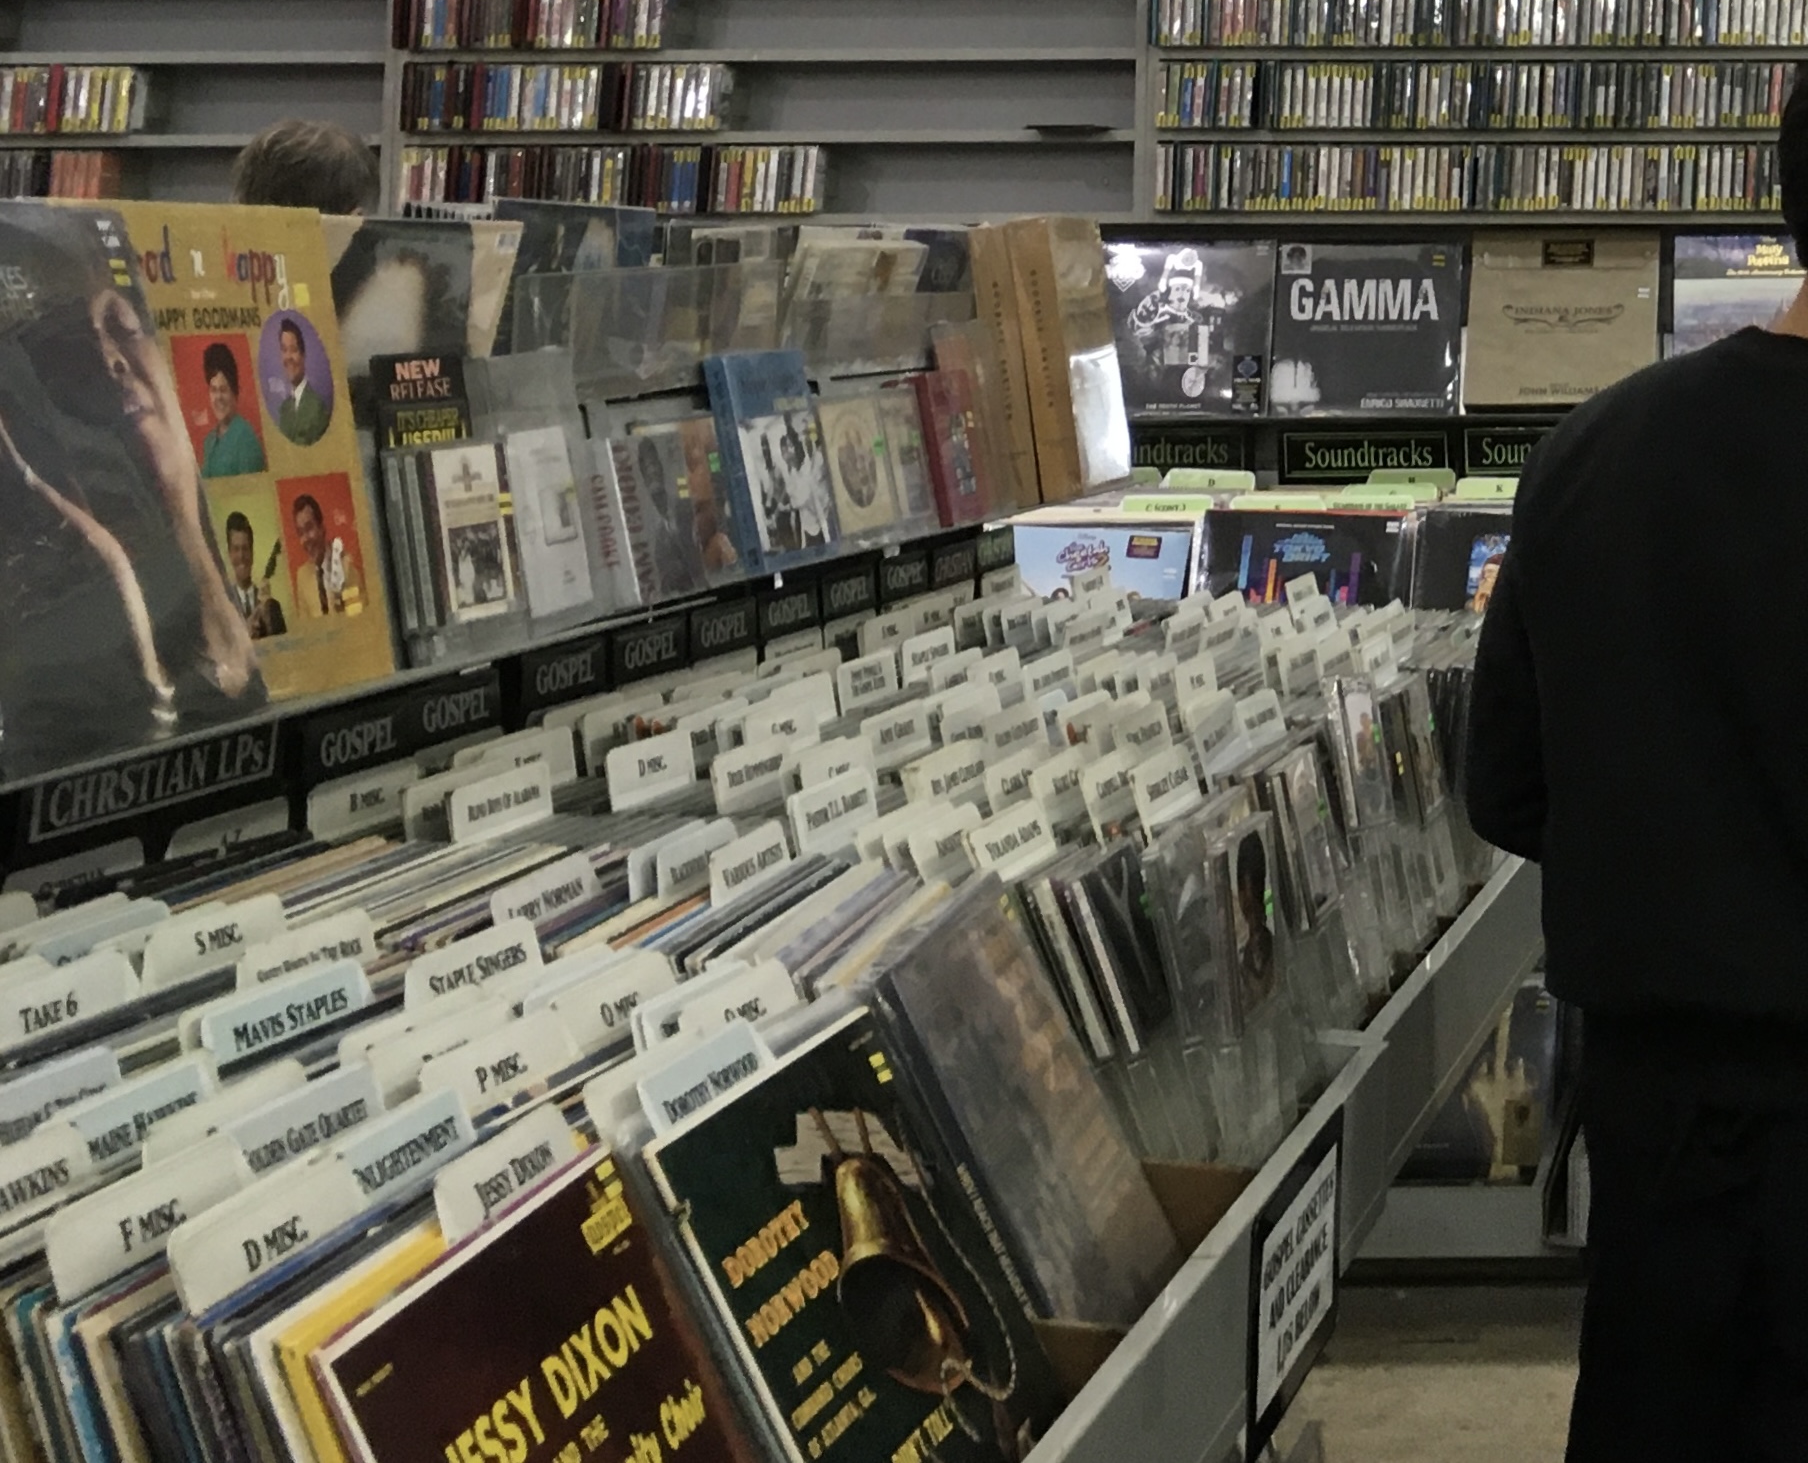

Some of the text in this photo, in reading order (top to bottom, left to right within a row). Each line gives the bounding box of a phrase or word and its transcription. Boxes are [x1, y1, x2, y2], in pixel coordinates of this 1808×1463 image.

[1290, 277, 1439, 322] GAMMA
[1515, 306, 1612, 316] INDIANA JONES
[389, 377, 451, 399] RELEASE
[394, 358, 441, 381] NEW
[1305, 440, 1433, 469] Soundtracks
[1274, 541, 1326, 553] TOKYO
[1282, 550, 1331, 563] DRIFT
[768, 594, 809, 627] GOSPEL
[830, 574, 869, 609] GOSPEL
[624, 631, 678, 671] GOSPEL
[701, 611, 748, 648] GOSPEL
[536, 649, 596, 696] GOSPEL
[422, 687, 490, 734] GOSPEL
[320, 717, 396, 768] GOSPEL
[429, 940, 527, 996] STAPLE SINGERS
[20, 991, 79, 1035] TAKE 6
[233, 988, 348, 1052] MAVIS STAPLES
[662, 1052, 759, 1125] DOROTHY NORWOOD
[475, 1140, 555, 1210] JESSY DIXON
[118, 1217, 134, 1252] F
[242, 1239, 262, 1273] D
[721, 1199, 810, 1290] DOROTHY
[1269, 1222, 1328, 1329] AND CLEARANCE
[744, 1249, 840, 1349] NORWOOD
[540, 1284, 654, 1420] DIXON
